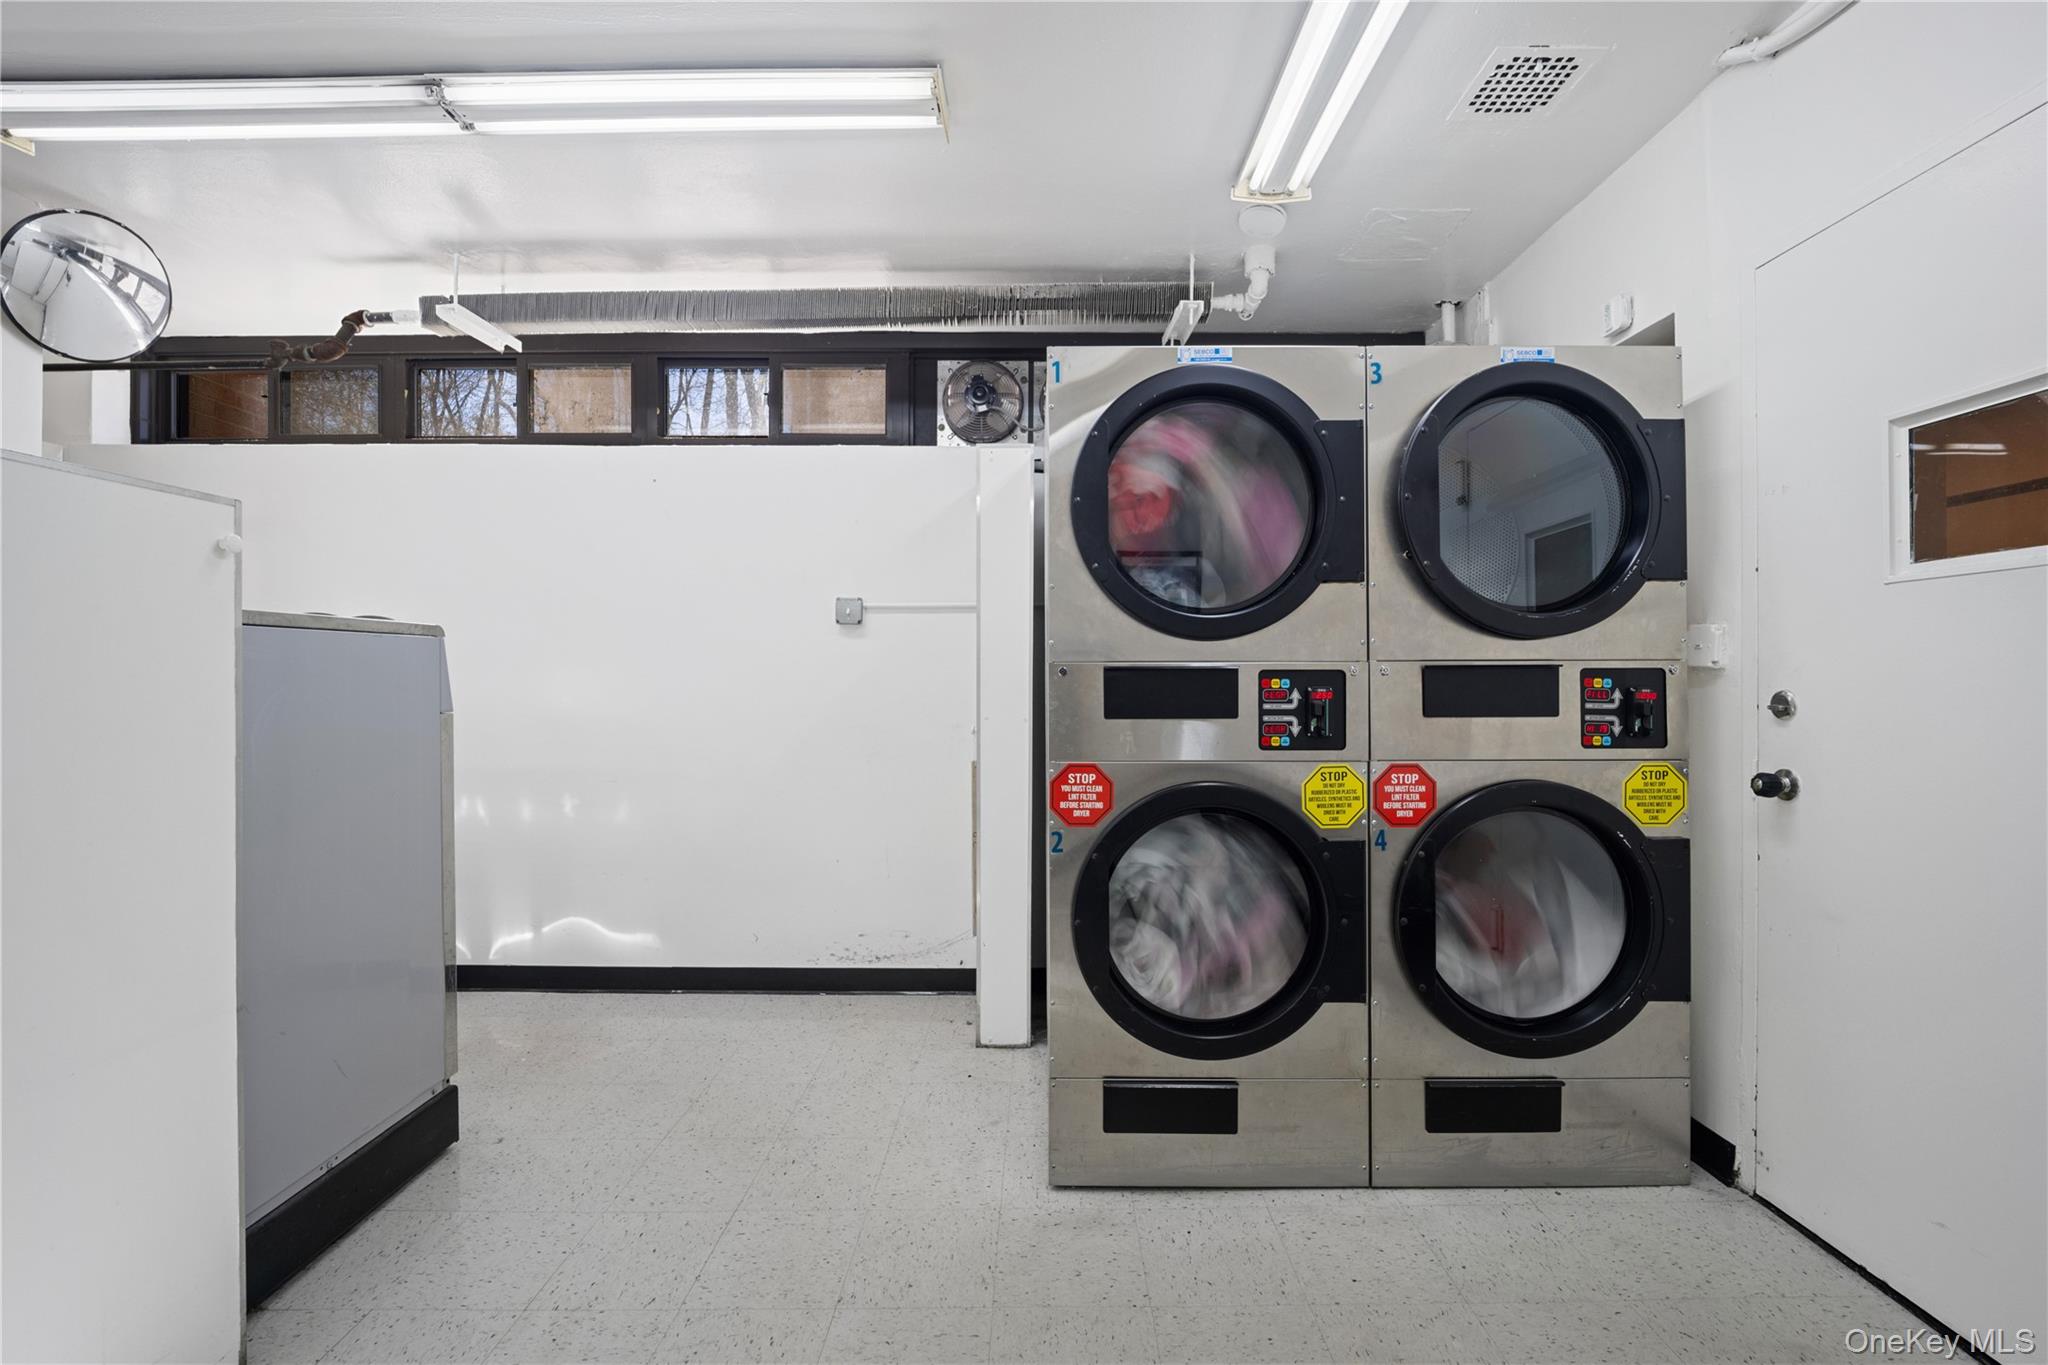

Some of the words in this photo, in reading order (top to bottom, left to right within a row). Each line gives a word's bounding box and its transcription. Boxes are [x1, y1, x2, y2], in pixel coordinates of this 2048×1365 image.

[1052, 360, 1060, 383] 1
[1370, 362, 1382, 384] 3
[1068, 773, 1096, 784] STOP
[1320, 771, 1348, 782] STOP
[1391, 773, 1419, 784] STOP
[1641, 770, 1669, 780] STOP
[1060, 801, 1079, 809] BEFORE
[1080, 801, 1104, 809] STARTING
[1383, 801, 1401, 809] BEFORE
[1403, 801, 1426, 809] STARTING
[1051, 831, 1063, 853] 2
[1375, 829, 1387, 851] 4
